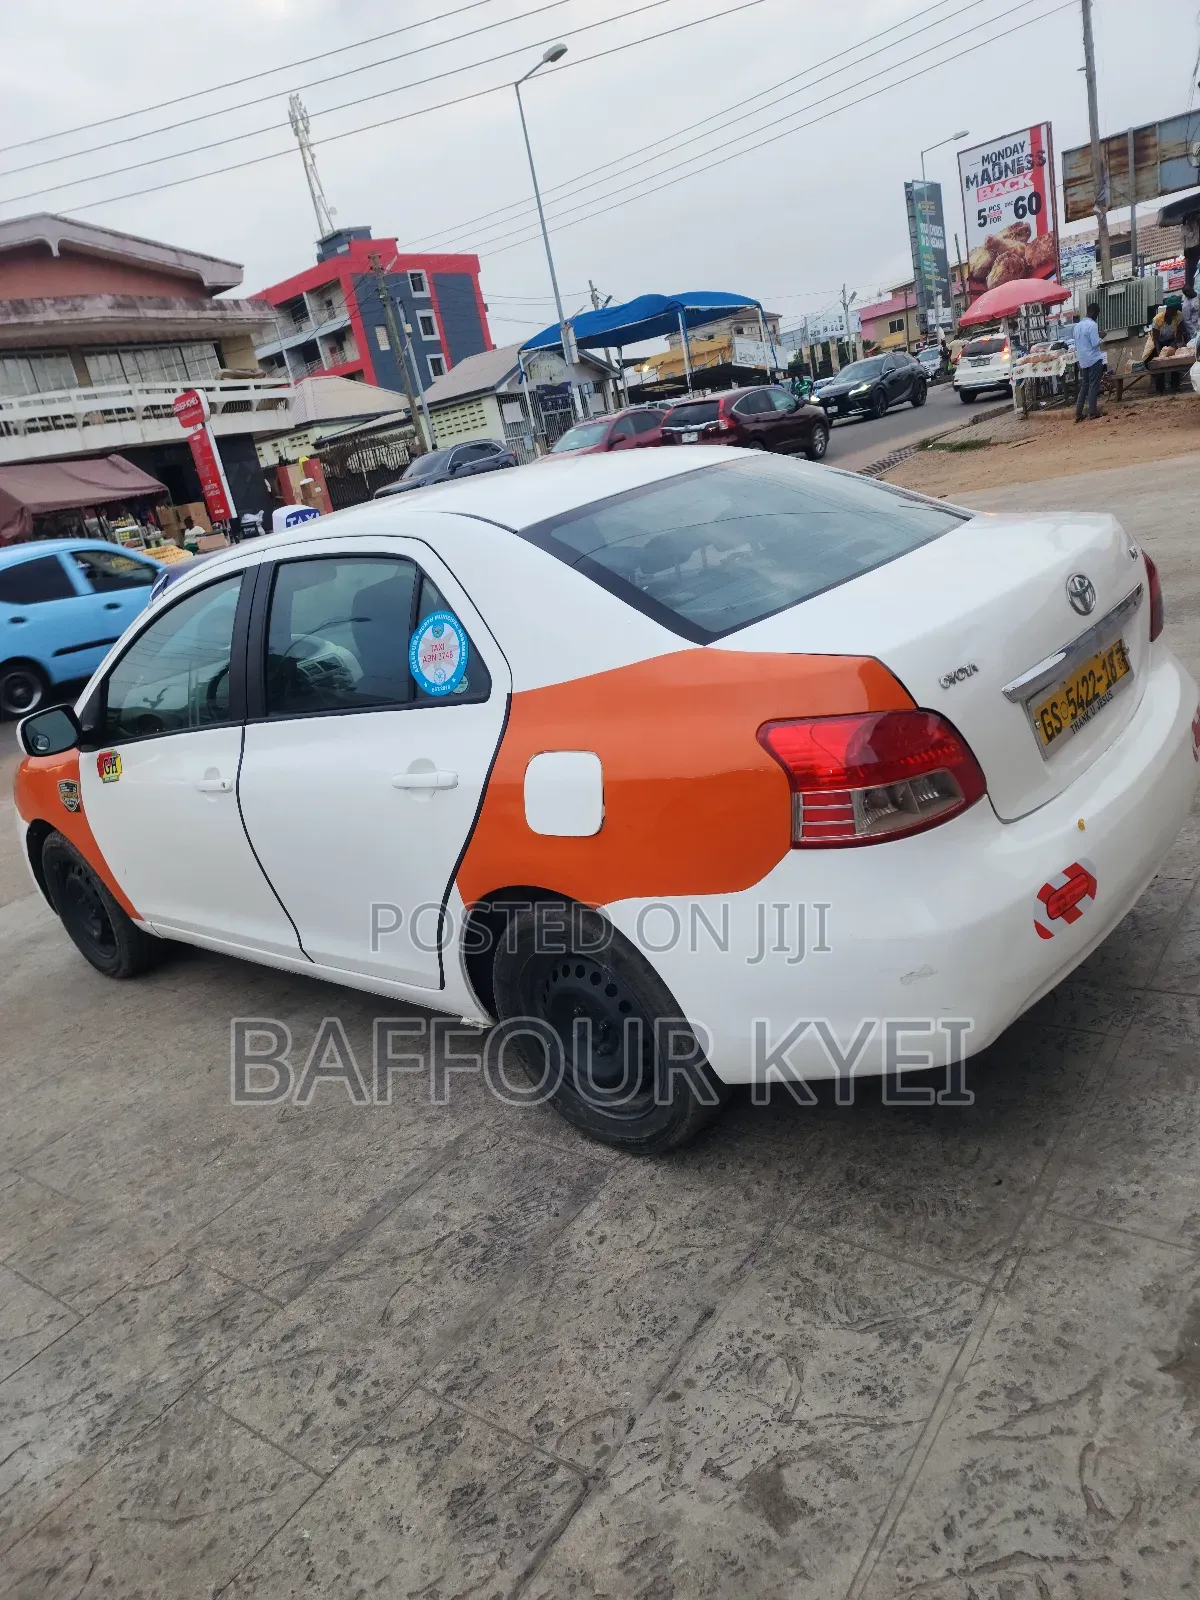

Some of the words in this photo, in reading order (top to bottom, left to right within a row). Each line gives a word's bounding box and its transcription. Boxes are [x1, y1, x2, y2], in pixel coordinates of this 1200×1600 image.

[981, 141, 1026, 167] MONDAY
[965, 150, 1047, 191] MADNESS
[978, 171, 1035, 201] BACK
[977, 208, 988, 228] 5
[988, 204, 1001, 213] PCS
[1013, 191, 1042, 220] 60
[989, 216, 1002, 225] FOR
[422, 653, 437, 664] ABN
[430, 642, 445, 653] TAXI
[1041, 701, 1063, 743] GS
[1070, 711, 1092, 735] THANK
[1089, 706, 1096, 716] U
[1096, 690, 1114, 710] JESUS
